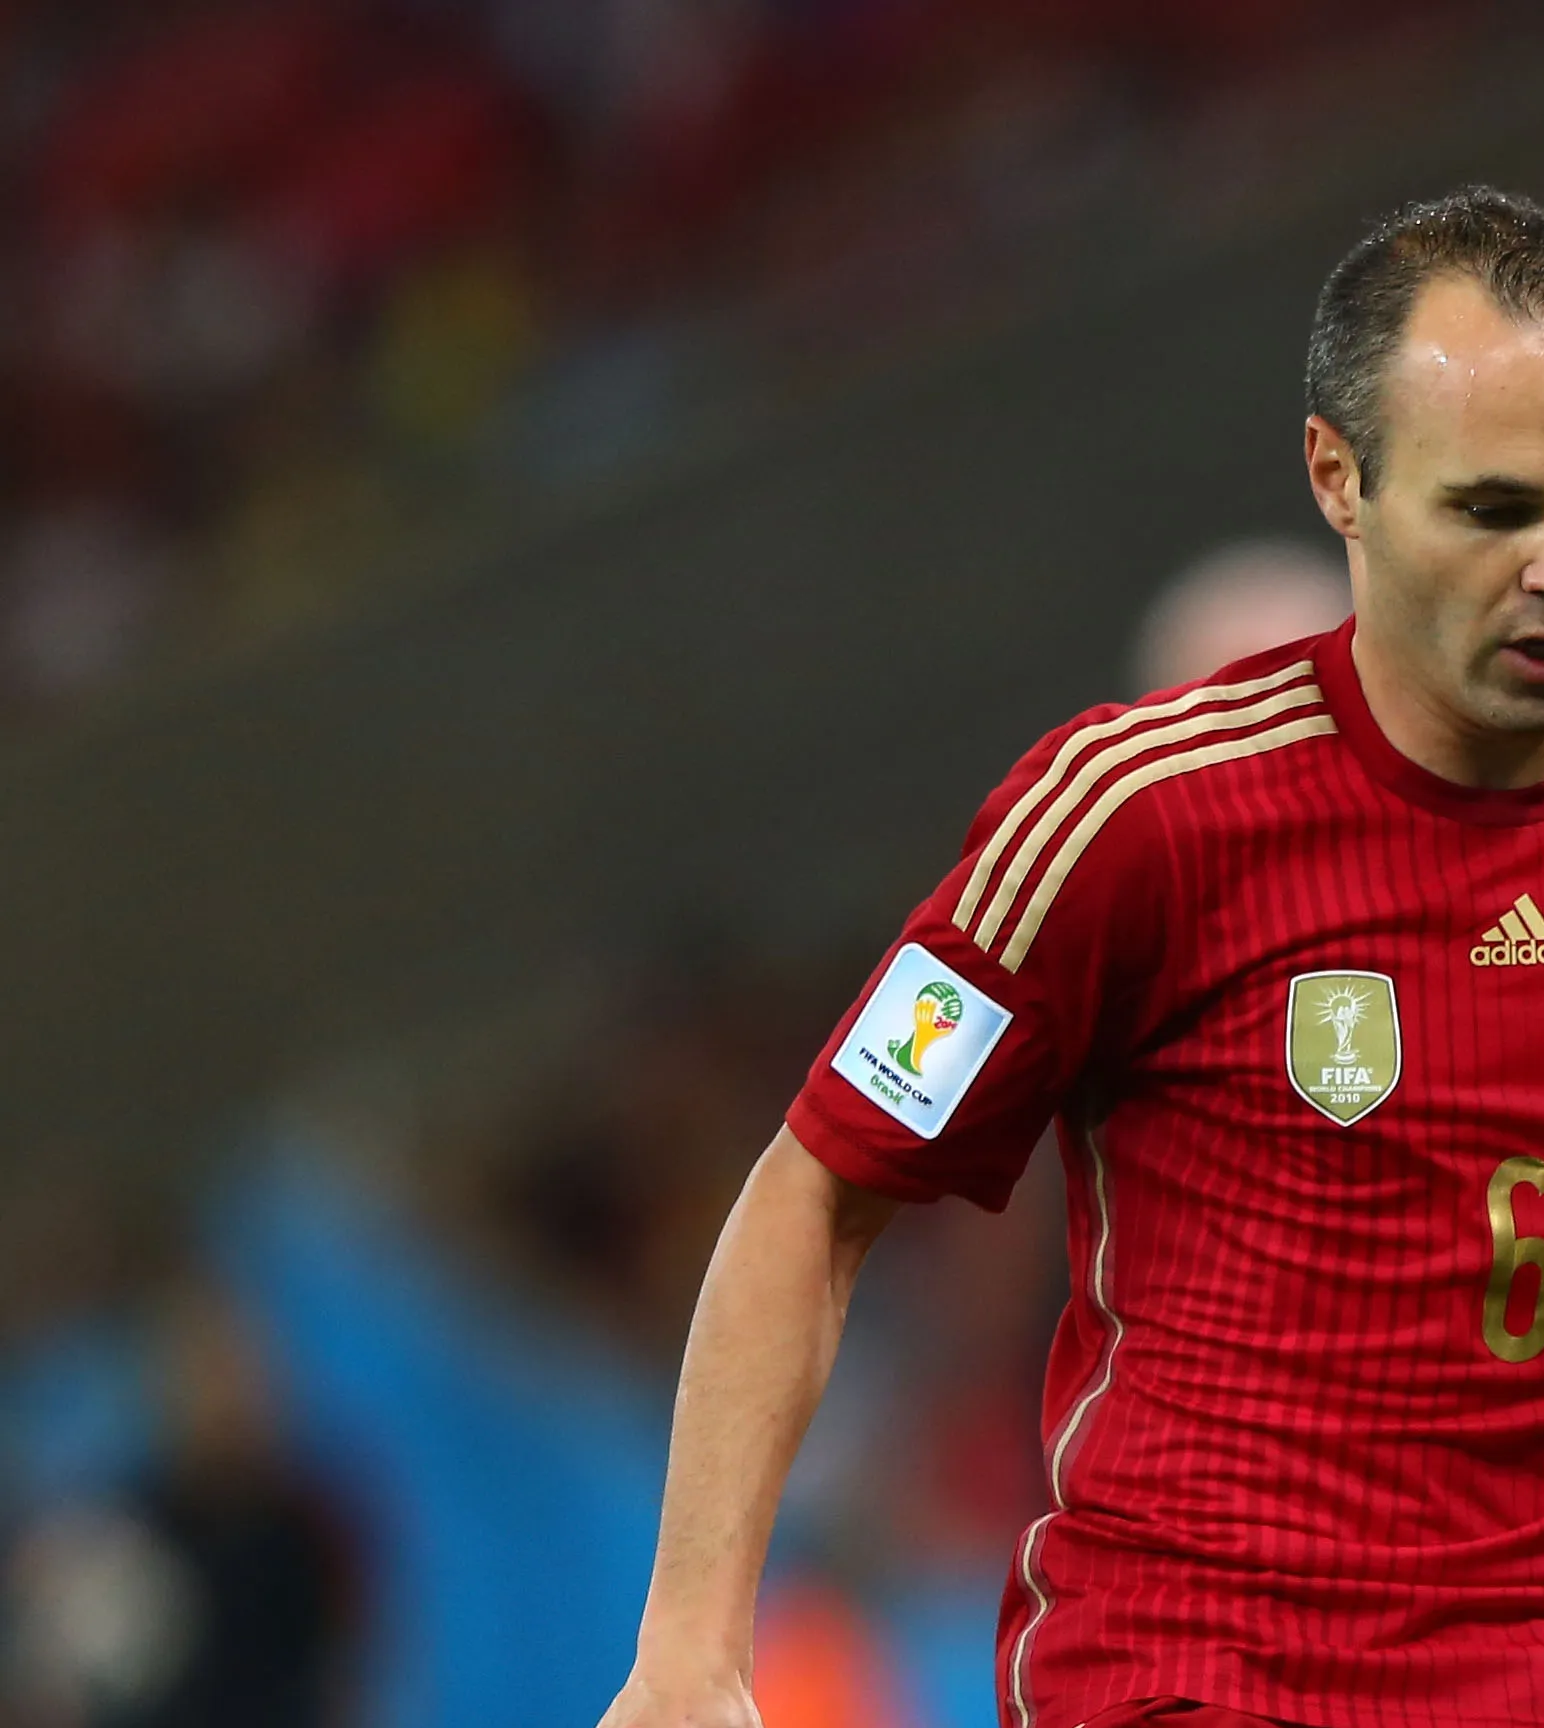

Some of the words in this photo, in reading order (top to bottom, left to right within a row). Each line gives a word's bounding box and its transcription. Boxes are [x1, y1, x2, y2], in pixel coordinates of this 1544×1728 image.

[859, 1046, 878, 1068] FIFA
[878, 1061, 912, 1093] WORLD
[911, 1089, 933, 1106] CUP
[1321, 1067, 1371, 1085] FIFA
[1330, 1093, 1360, 1104] 2010
